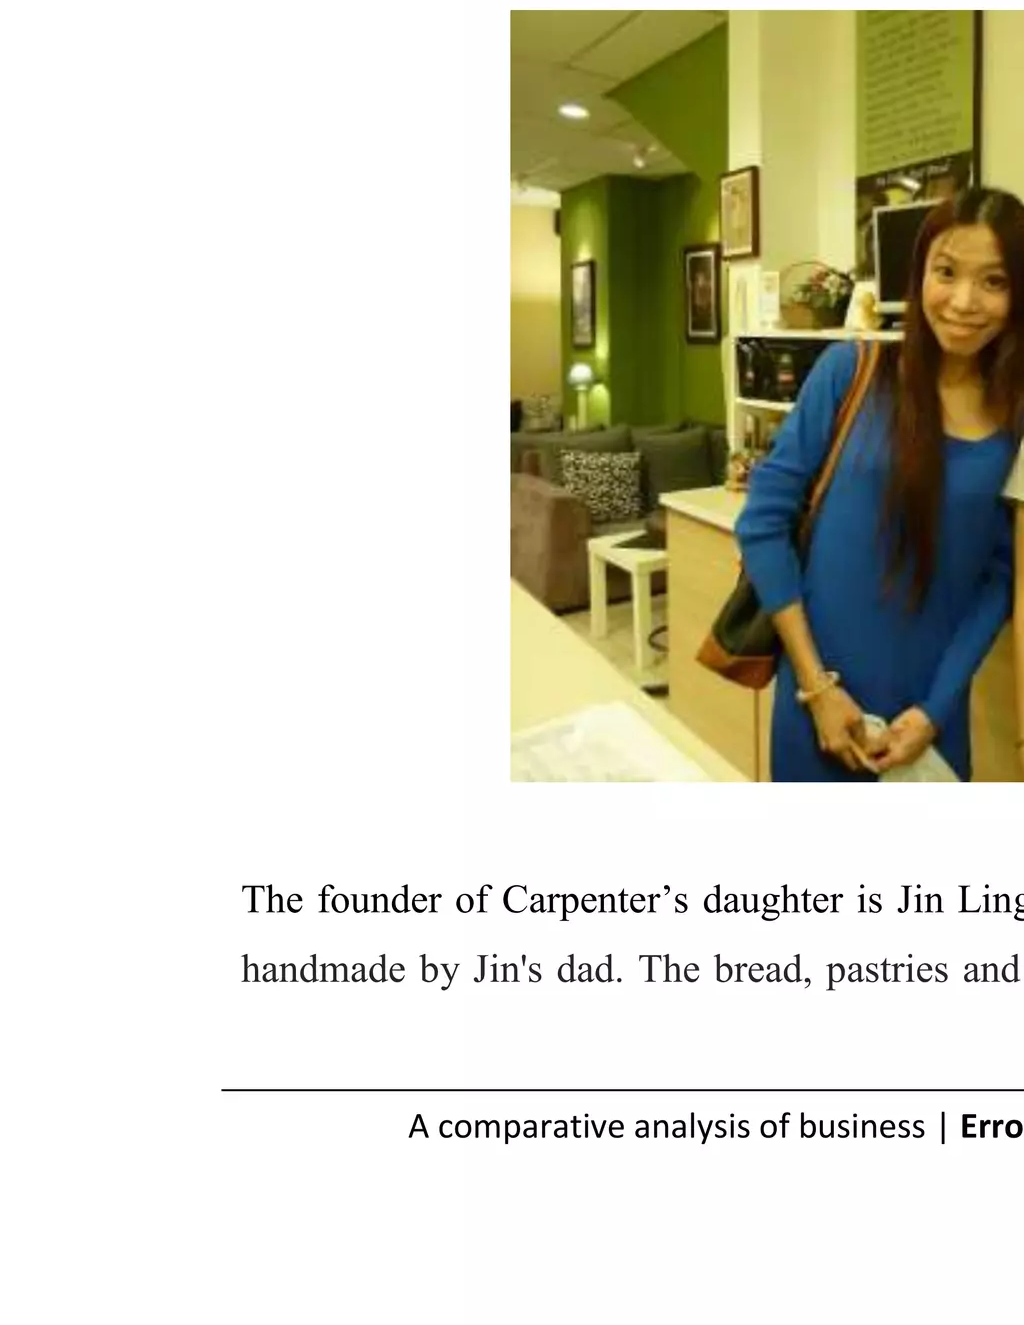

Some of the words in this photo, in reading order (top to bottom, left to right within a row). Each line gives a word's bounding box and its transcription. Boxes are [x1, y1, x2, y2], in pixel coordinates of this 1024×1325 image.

[242, 884, 302, 913] The
[318, 884, 442, 913] founder
[456, 884, 493, 913] of
[503, 885, 688, 921] Carpenter’s
[704, 884, 843, 921] daughter
[858, 884, 882, 913] is
[898, 884, 944, 913] Jin
[242, 954, 405, 982] handmade
[419, 954, 460, 991] by
[474, 954, 541, 982] Jin's
[558, 954, 622, 982] dad.
[639, 954, 699, 982] The
[714, 954, 811, 988] bread,
[826, 954, 948, 991] pastries
[964, 954, 1020, 982] and
[409, 1114, 429, 1138] A
[439, 1113, 624, 1144] comparative
[635, 1112, 750, 1144] analysis
[760, 1112, 790, 1138] of
[801, 1112, 925, 1138] business
